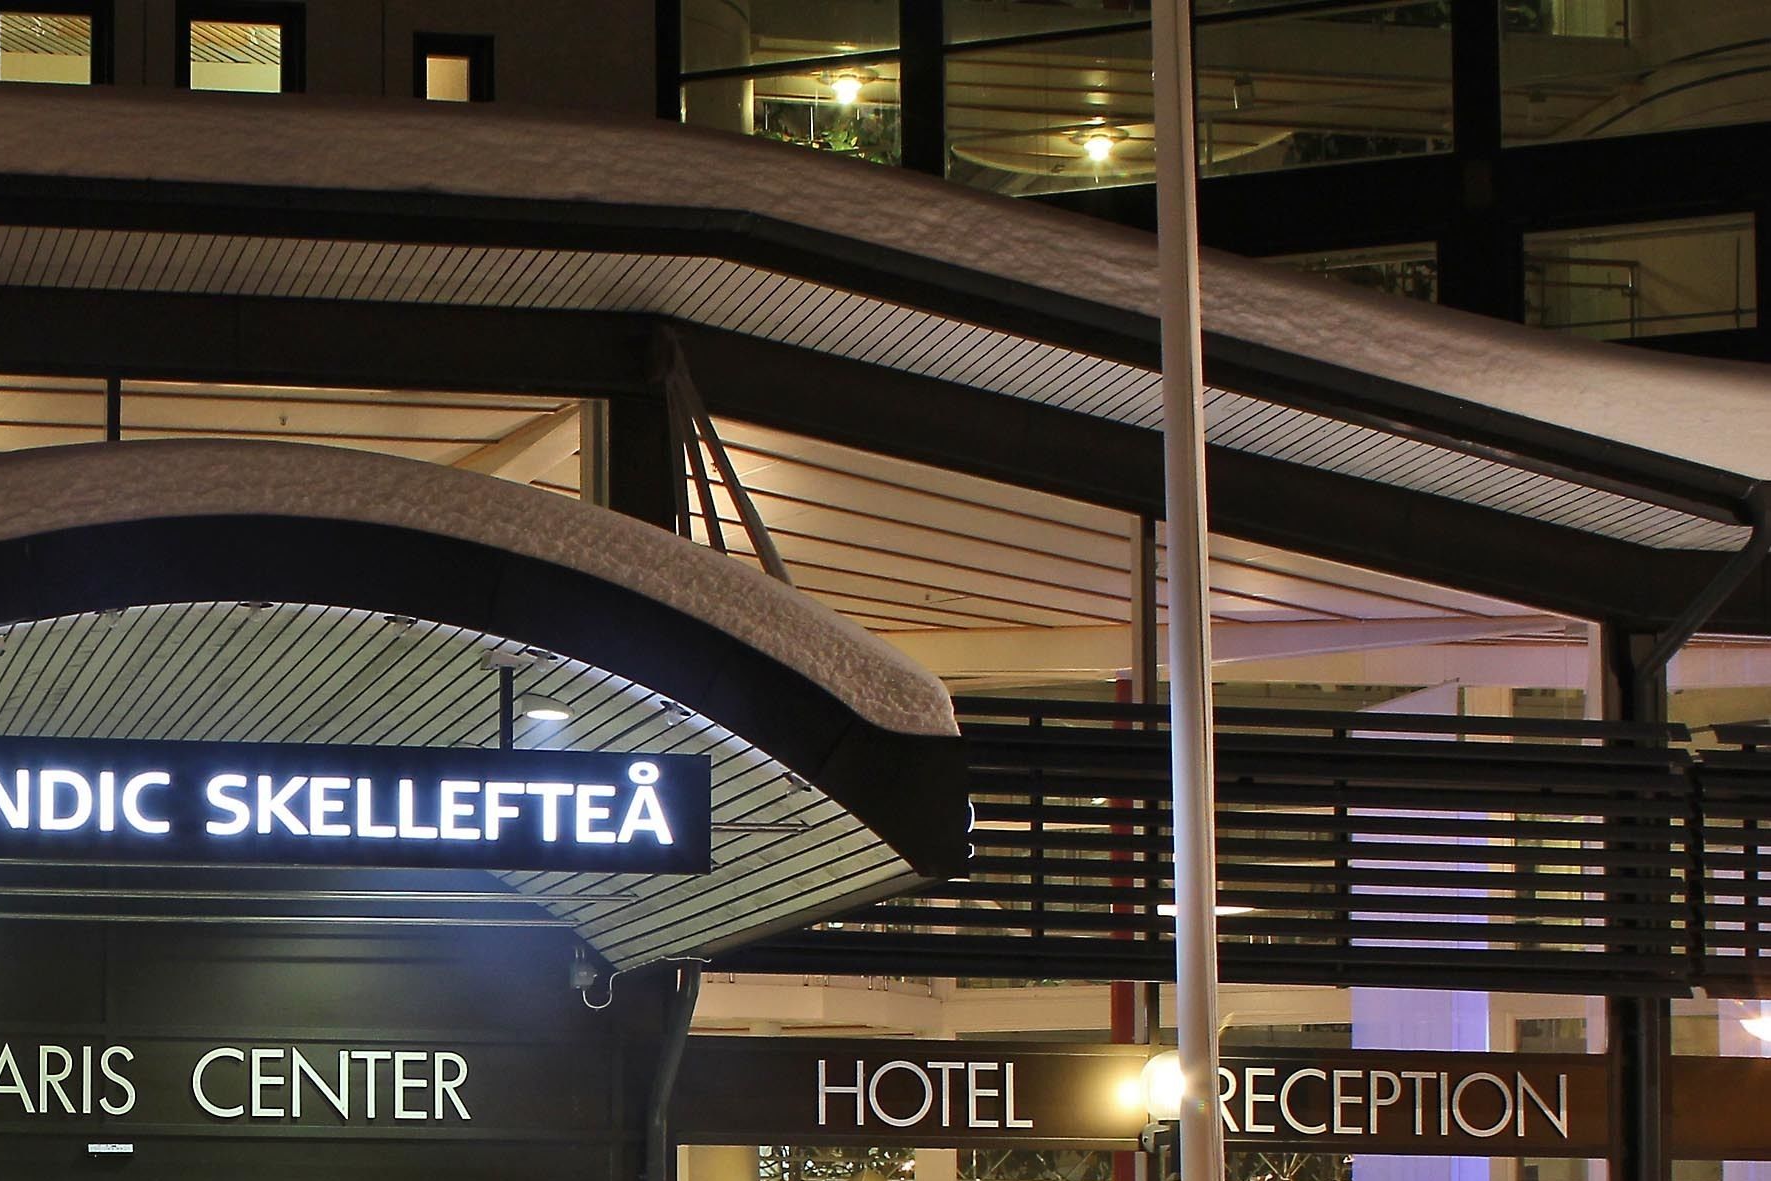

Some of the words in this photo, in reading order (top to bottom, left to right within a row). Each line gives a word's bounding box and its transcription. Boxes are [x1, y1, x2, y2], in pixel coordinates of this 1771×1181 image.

[204, 760, 675, 846] SKELLEFTEÅ
[191, 1047, 471, 1120] CENTER
[817, 1059, 1034, 1129] HOTEL
[1218, 1067, 1568, 1139] RECEPTION
